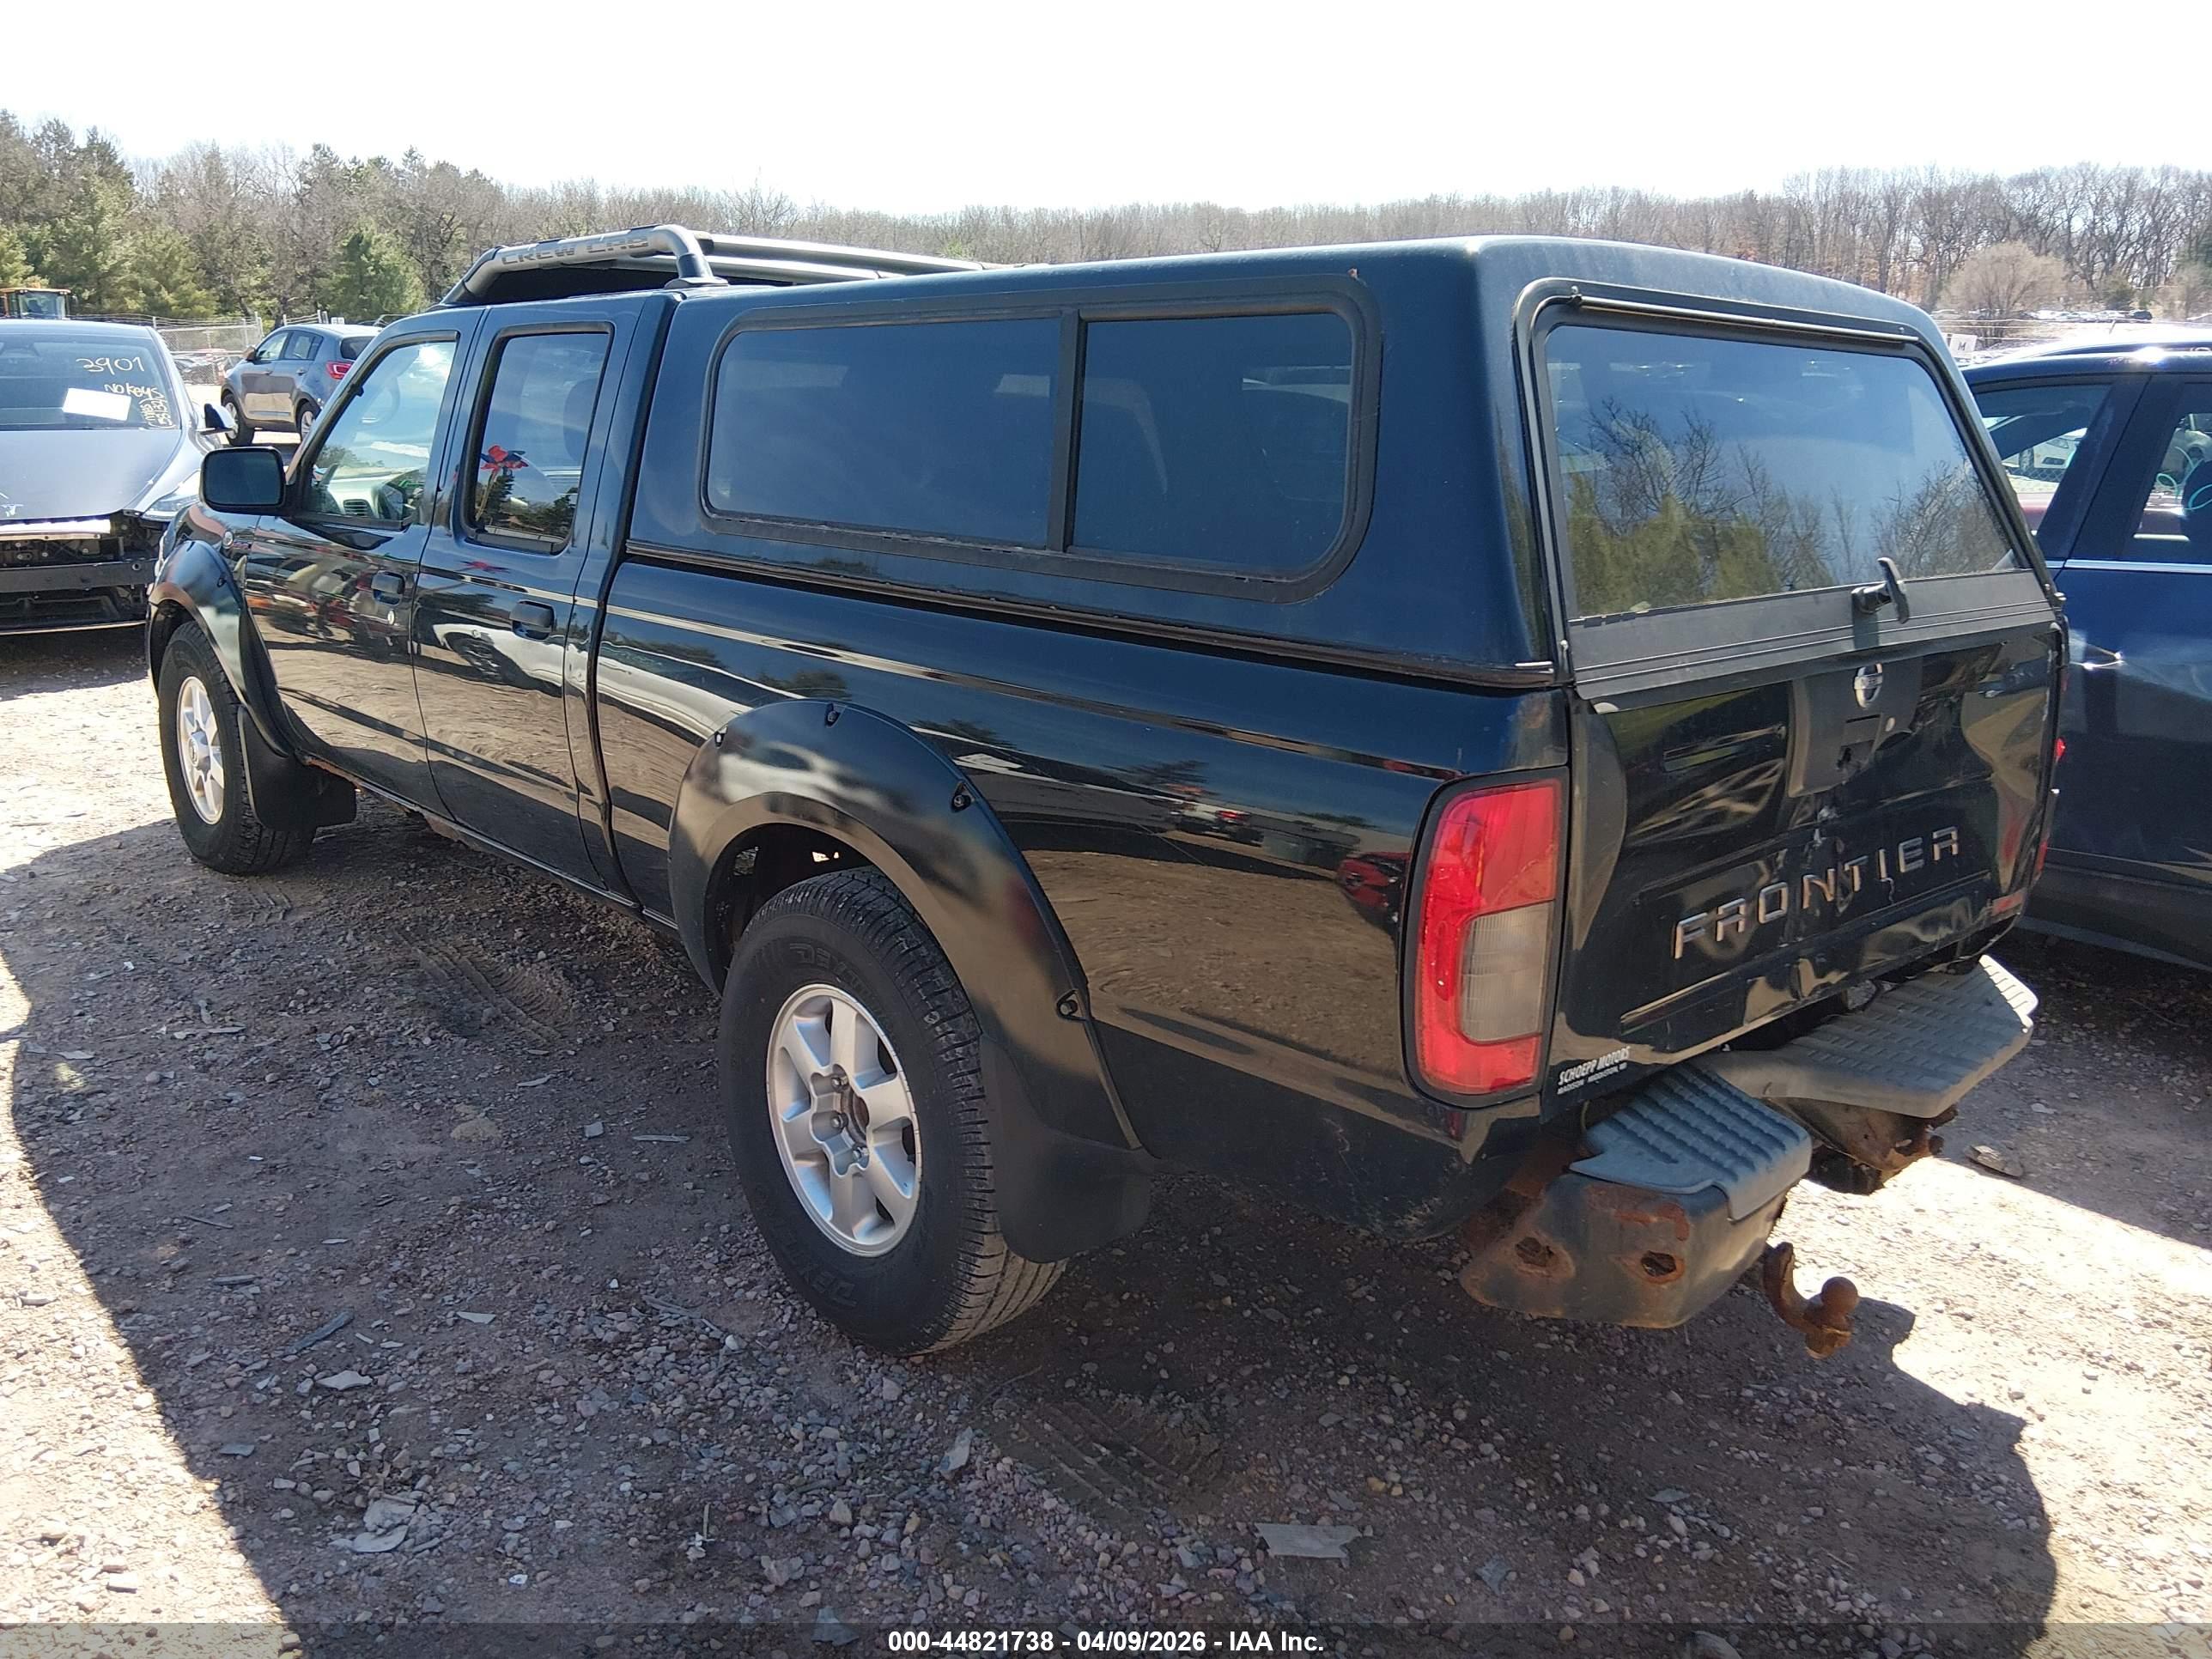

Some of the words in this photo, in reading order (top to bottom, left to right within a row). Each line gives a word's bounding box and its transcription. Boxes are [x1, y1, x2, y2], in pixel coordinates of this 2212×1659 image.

[502, 249, 576, 264] CREW
[587, 238, 649, 252] CAB
[75, 356, 144, 375] 3901
[1674, 826, 1958, 959] FRONTIER
[1558, 1059, 1597, 1085] SCHOEPP
